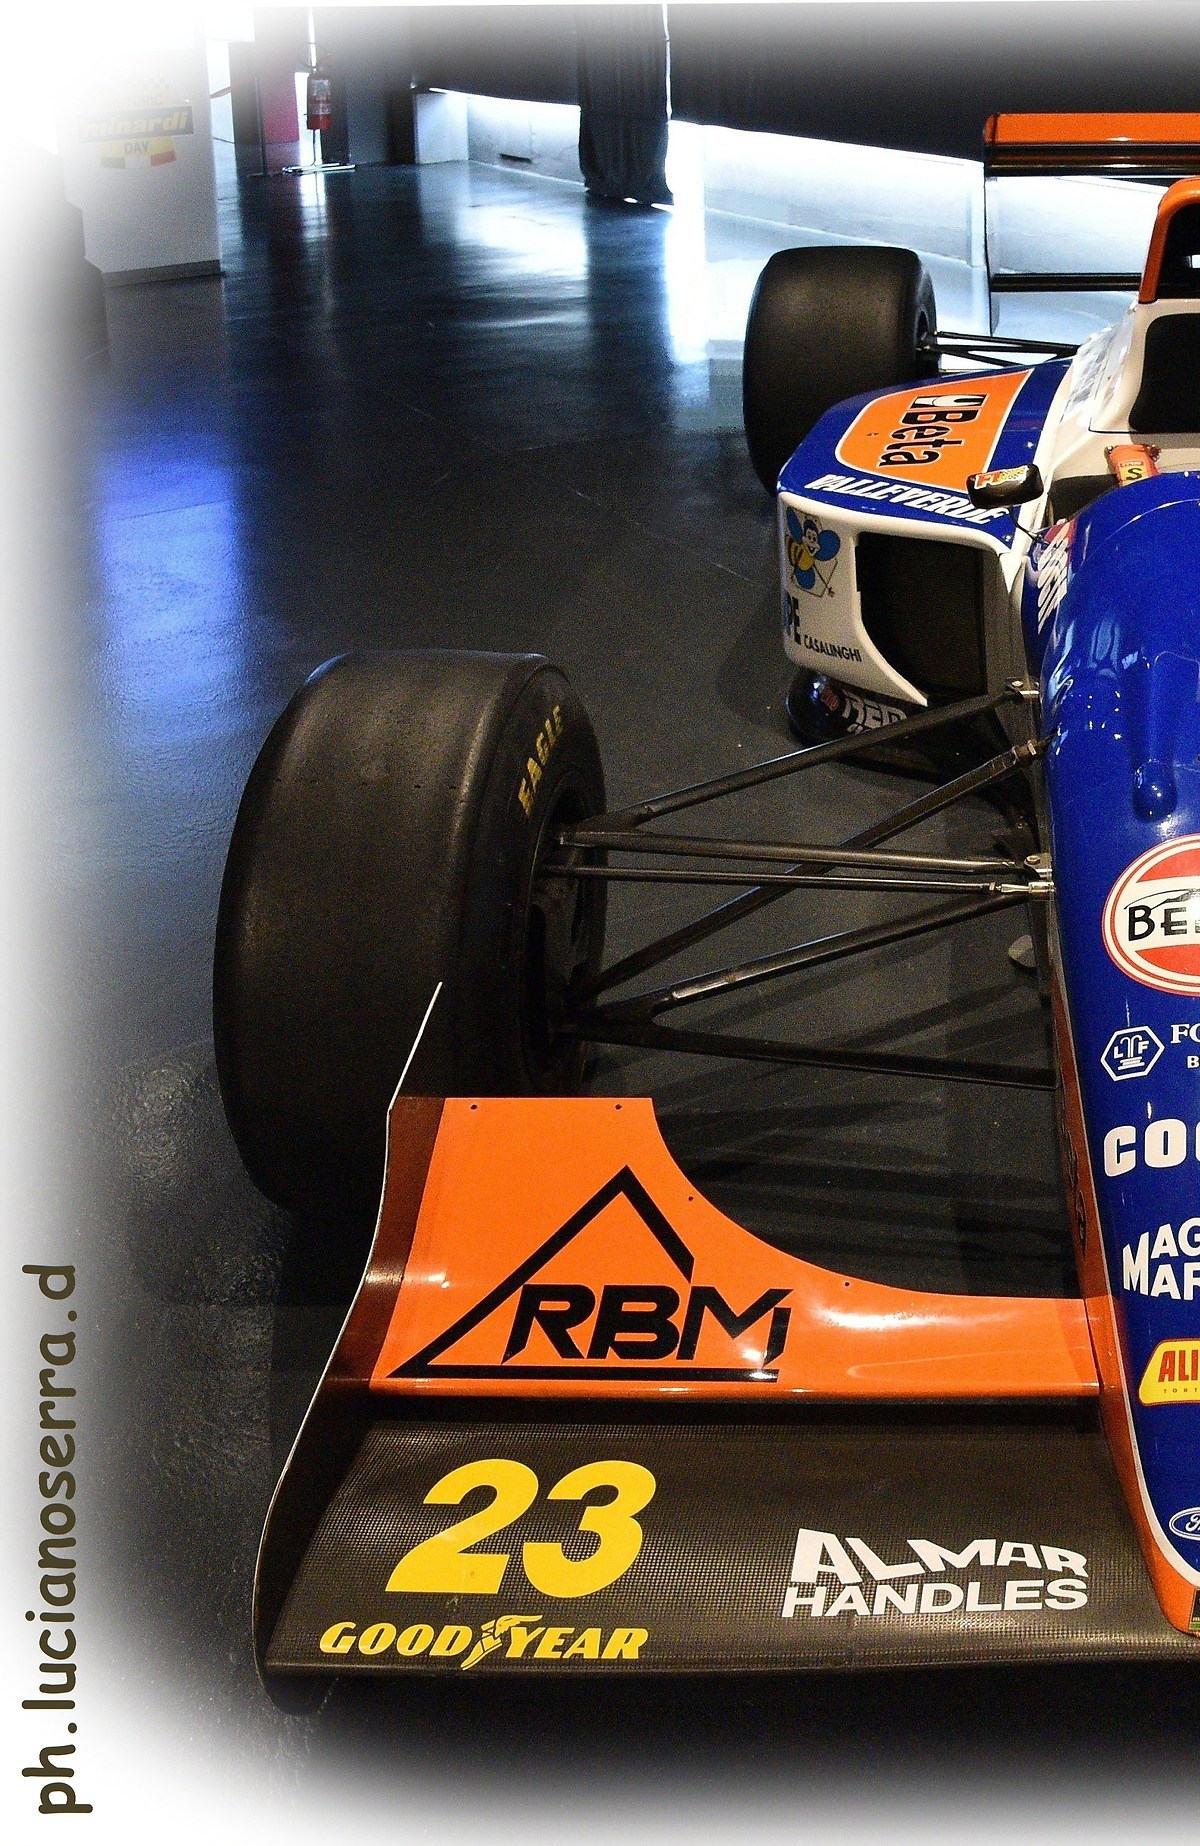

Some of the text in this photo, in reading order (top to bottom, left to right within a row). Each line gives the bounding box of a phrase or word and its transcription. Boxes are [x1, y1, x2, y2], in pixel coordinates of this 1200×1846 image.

[81, 110, 189, 138] minardi
[123, 140, 151, 155] DAY
[879, 409, 980, 467] Beta
[803, 634, 863, 663] CASALINGHI
[517, 704, 564, 818] EAGLE
[501, 1283, 794, 1366] RBM
[385, 1458, 657, 1598] 23
[790, 1528, 1089, 1584] ALMAR
[781, 1578, 1089, 1618] HANDLES
